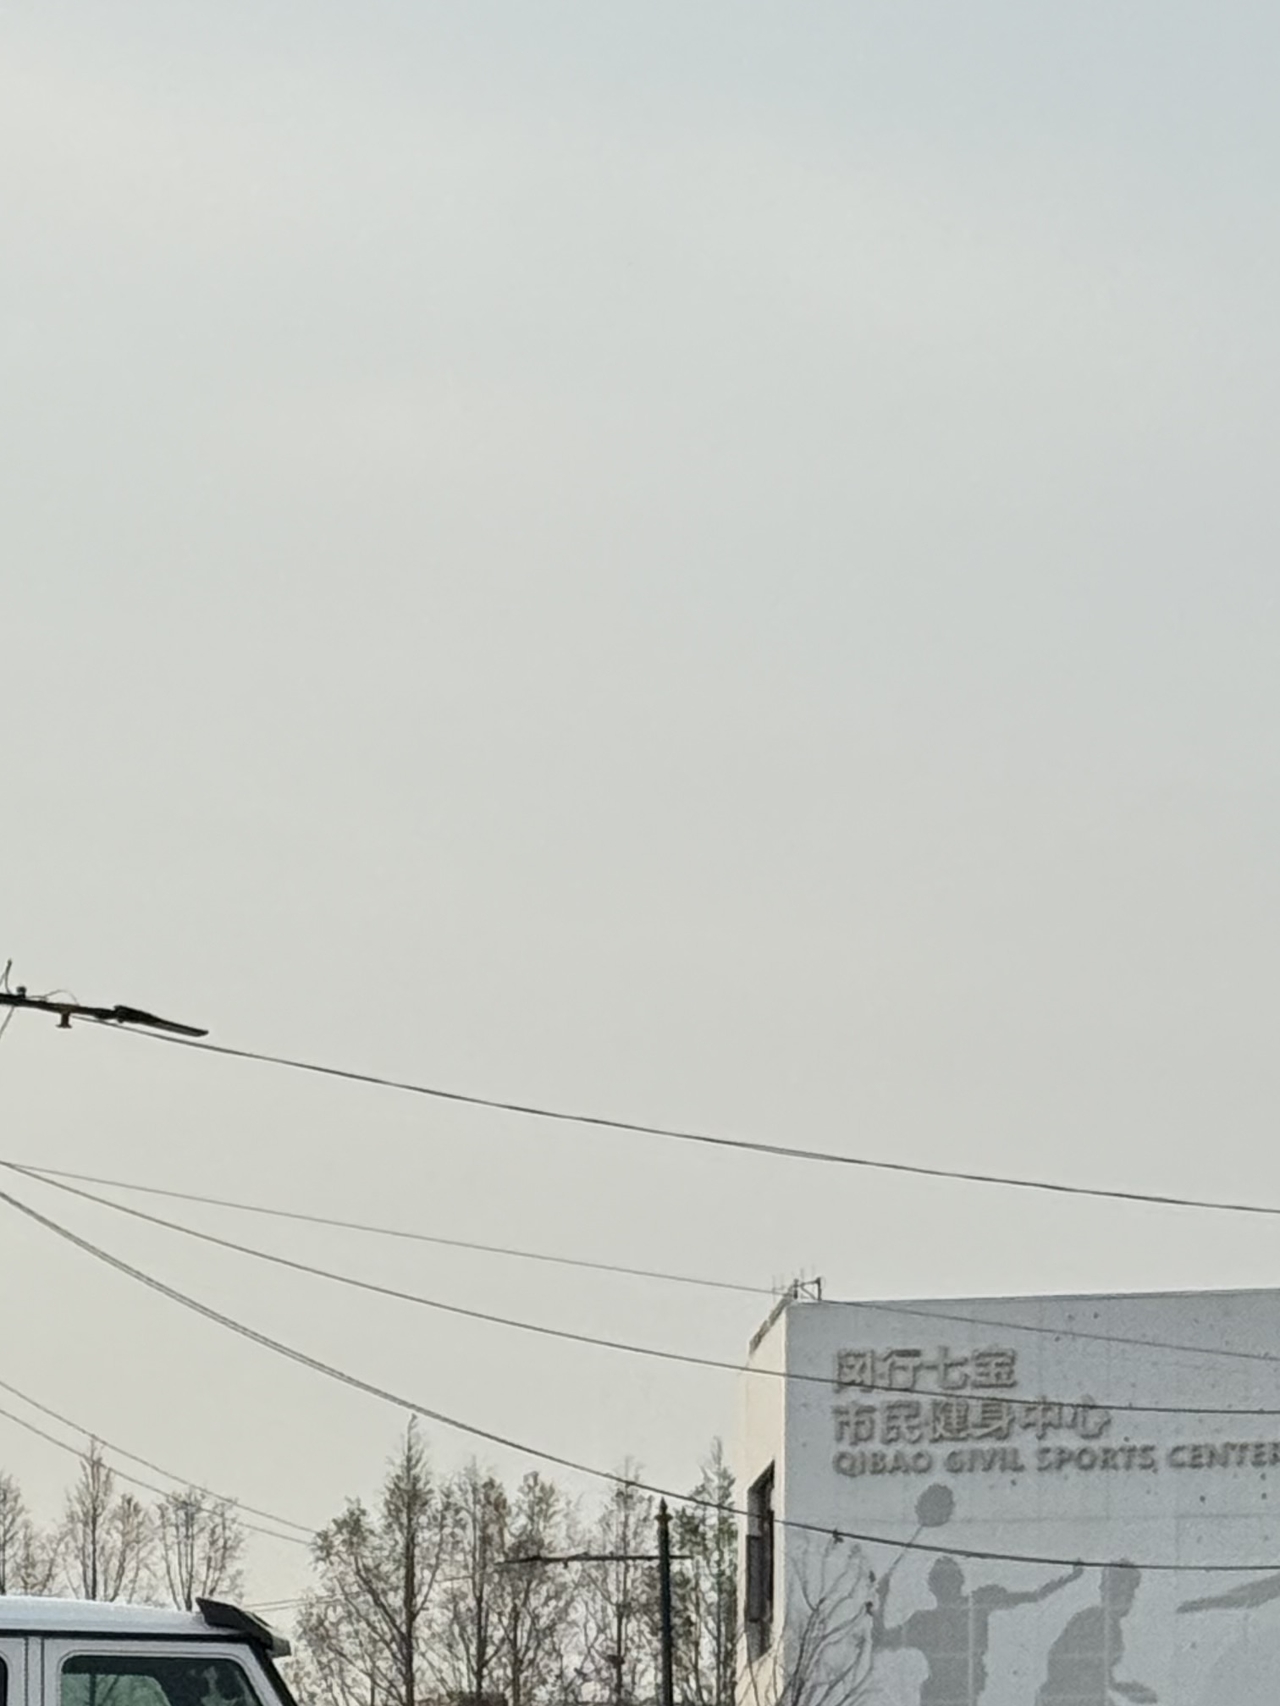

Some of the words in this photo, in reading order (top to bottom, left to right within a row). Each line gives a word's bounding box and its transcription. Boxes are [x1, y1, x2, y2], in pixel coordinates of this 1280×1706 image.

[833, 1346, 1017, 1392] 闵行七宝
[831, 1395, 1112, 1446] 市民健身中心
[832, 1450, 933, 1477] QIBAO
[1035, 1443, 1157, 1472] SPORTS
